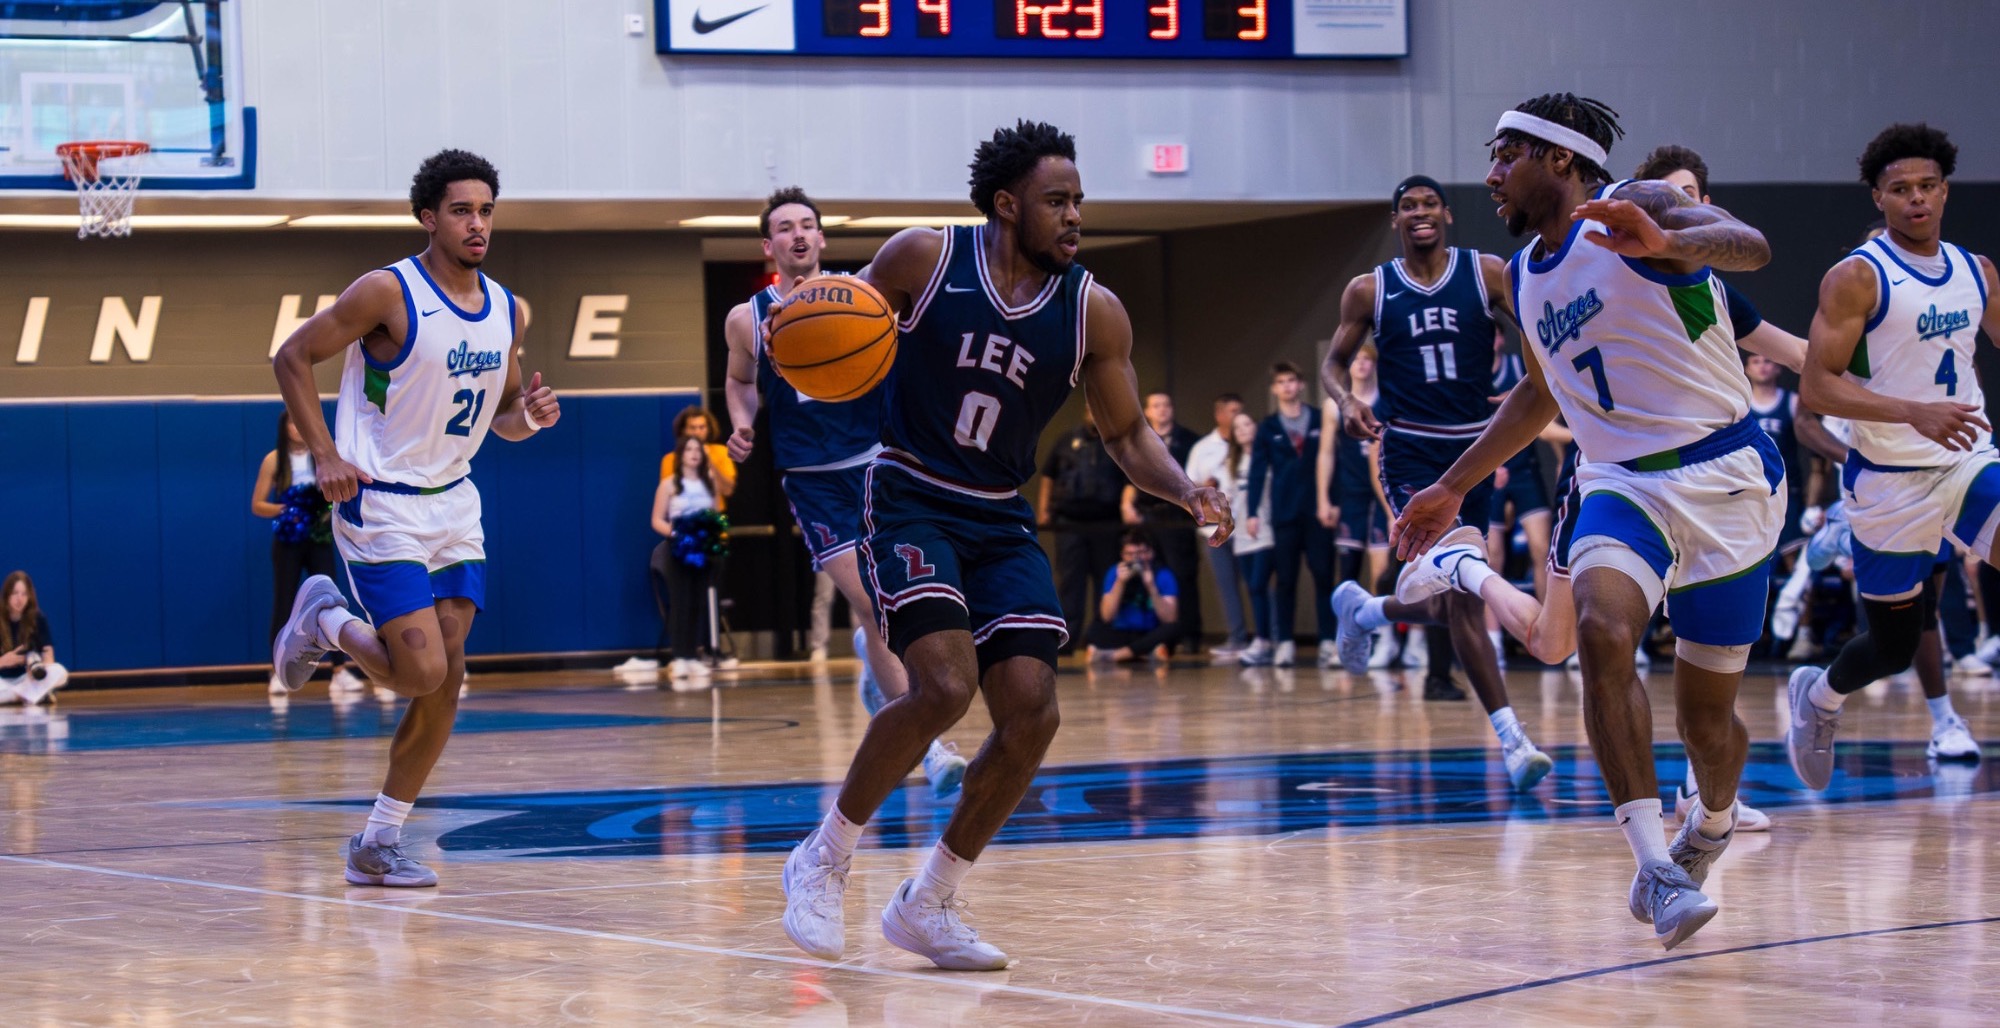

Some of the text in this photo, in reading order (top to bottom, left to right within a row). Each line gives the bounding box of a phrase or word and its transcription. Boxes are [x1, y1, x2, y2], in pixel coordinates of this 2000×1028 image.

[15, 293, 629, 363] IN HE
[1408, 307, 1460, 337] LEE
[1537, 287, 1604, 358] Argos
[1917, 303, 1970, 342] Argos
[447, 340, 502, 378] Argos
[956, 332, 1035, 390] LEE
[1419, 342, 1458, 382] 11
[1571, 345, 1615, 412] 7
[1934, 348, 1958, 396] 4
[445, 389, 486, 437] 21
[953, 390, 1002, 452] 0
